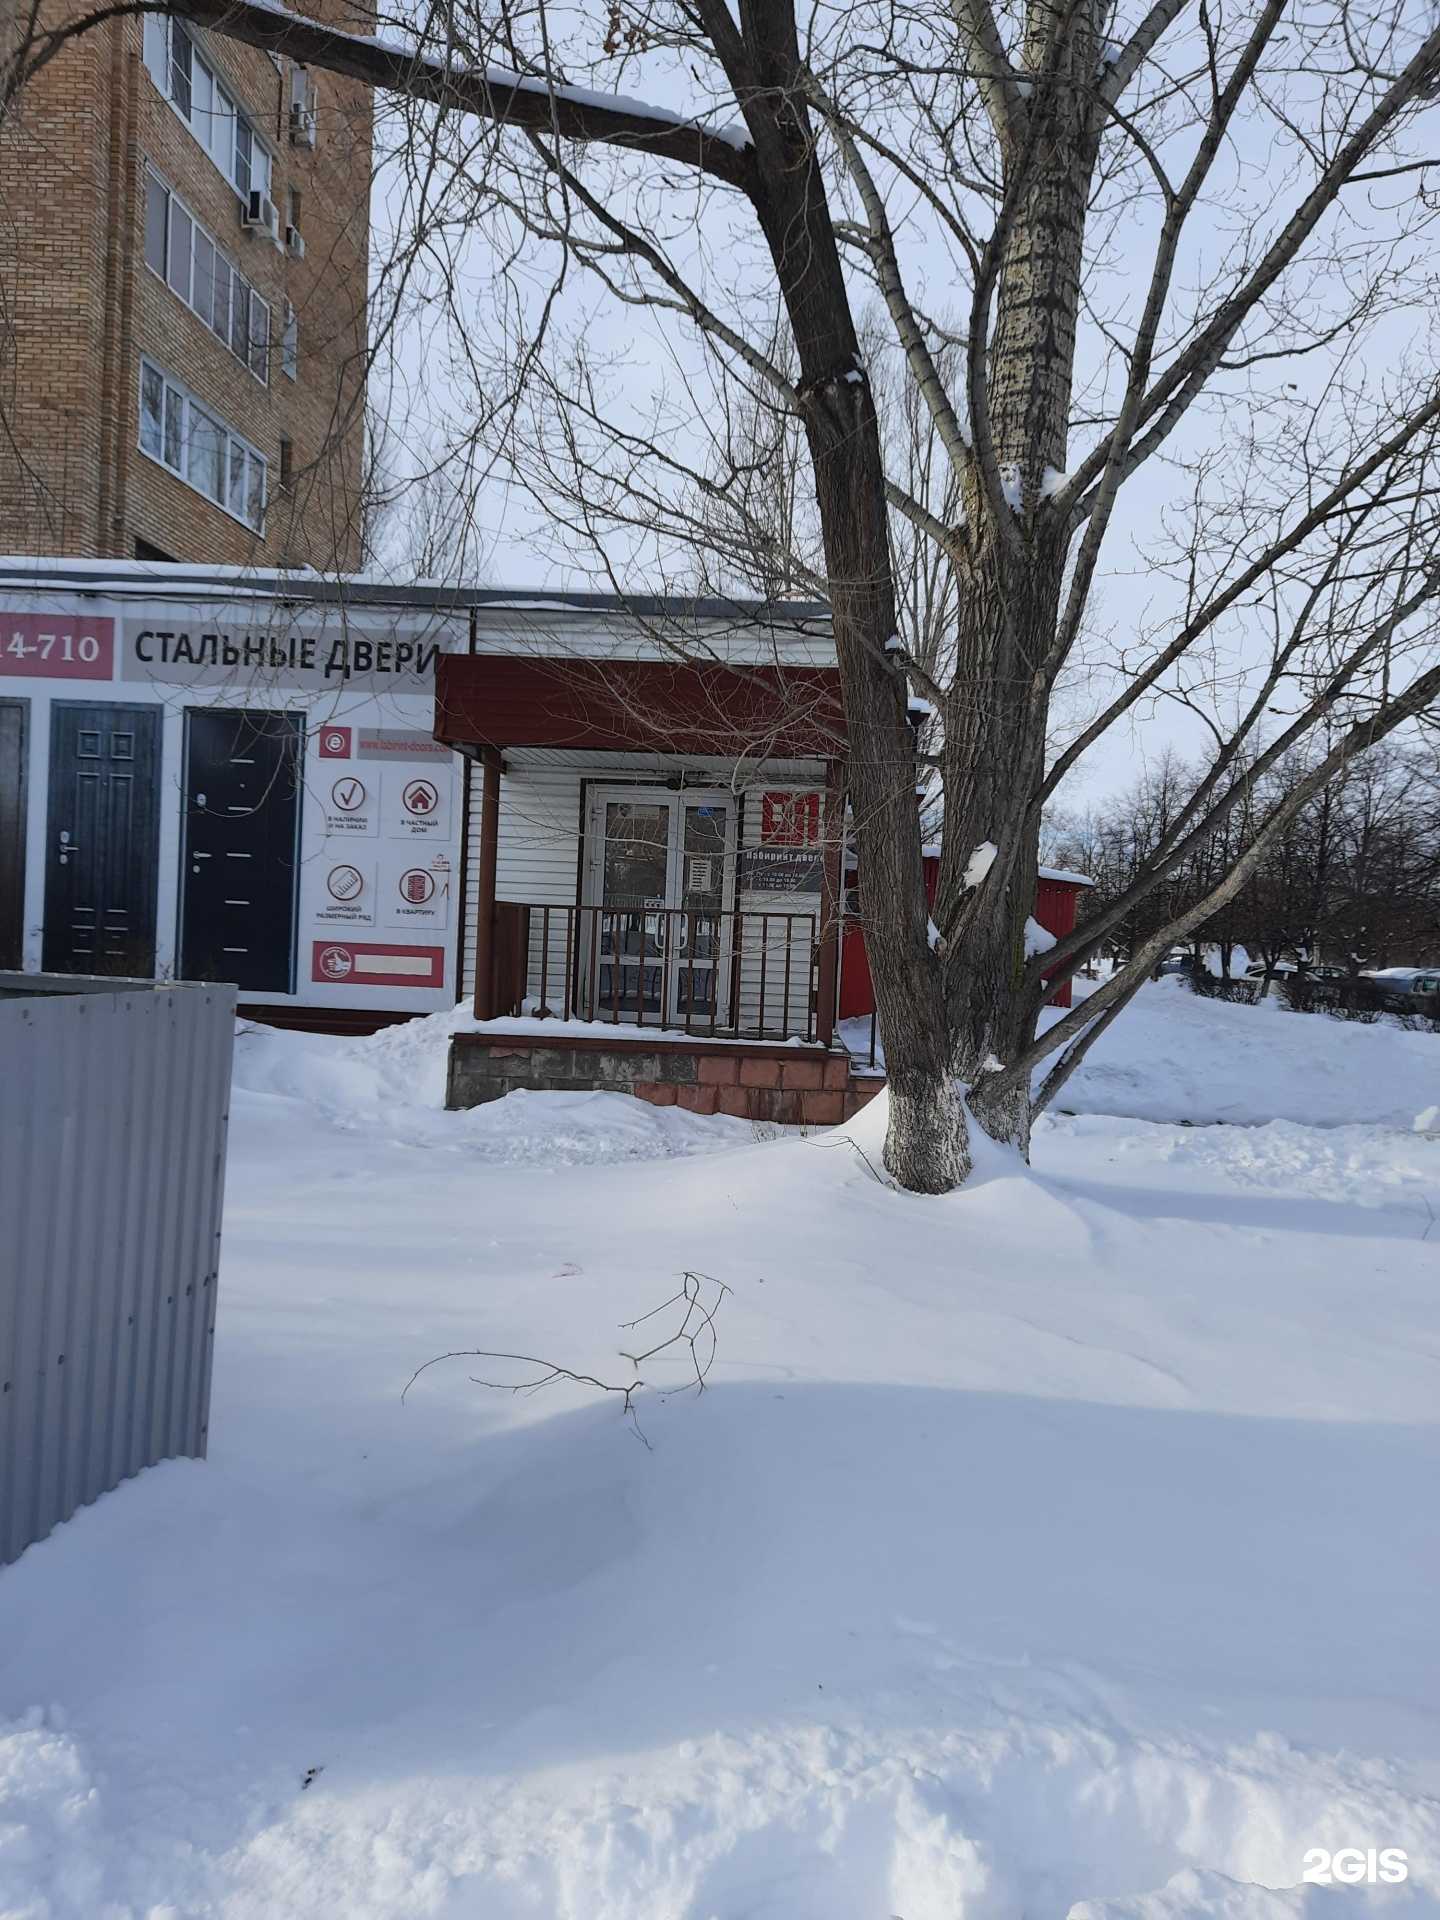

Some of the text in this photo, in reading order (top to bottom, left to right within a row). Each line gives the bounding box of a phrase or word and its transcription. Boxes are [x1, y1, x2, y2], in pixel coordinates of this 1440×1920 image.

[0, 631, 100, 662] 4-710
[135, 631, 440, 679] СТАЛЬНЫЕ ДВЕРИ
